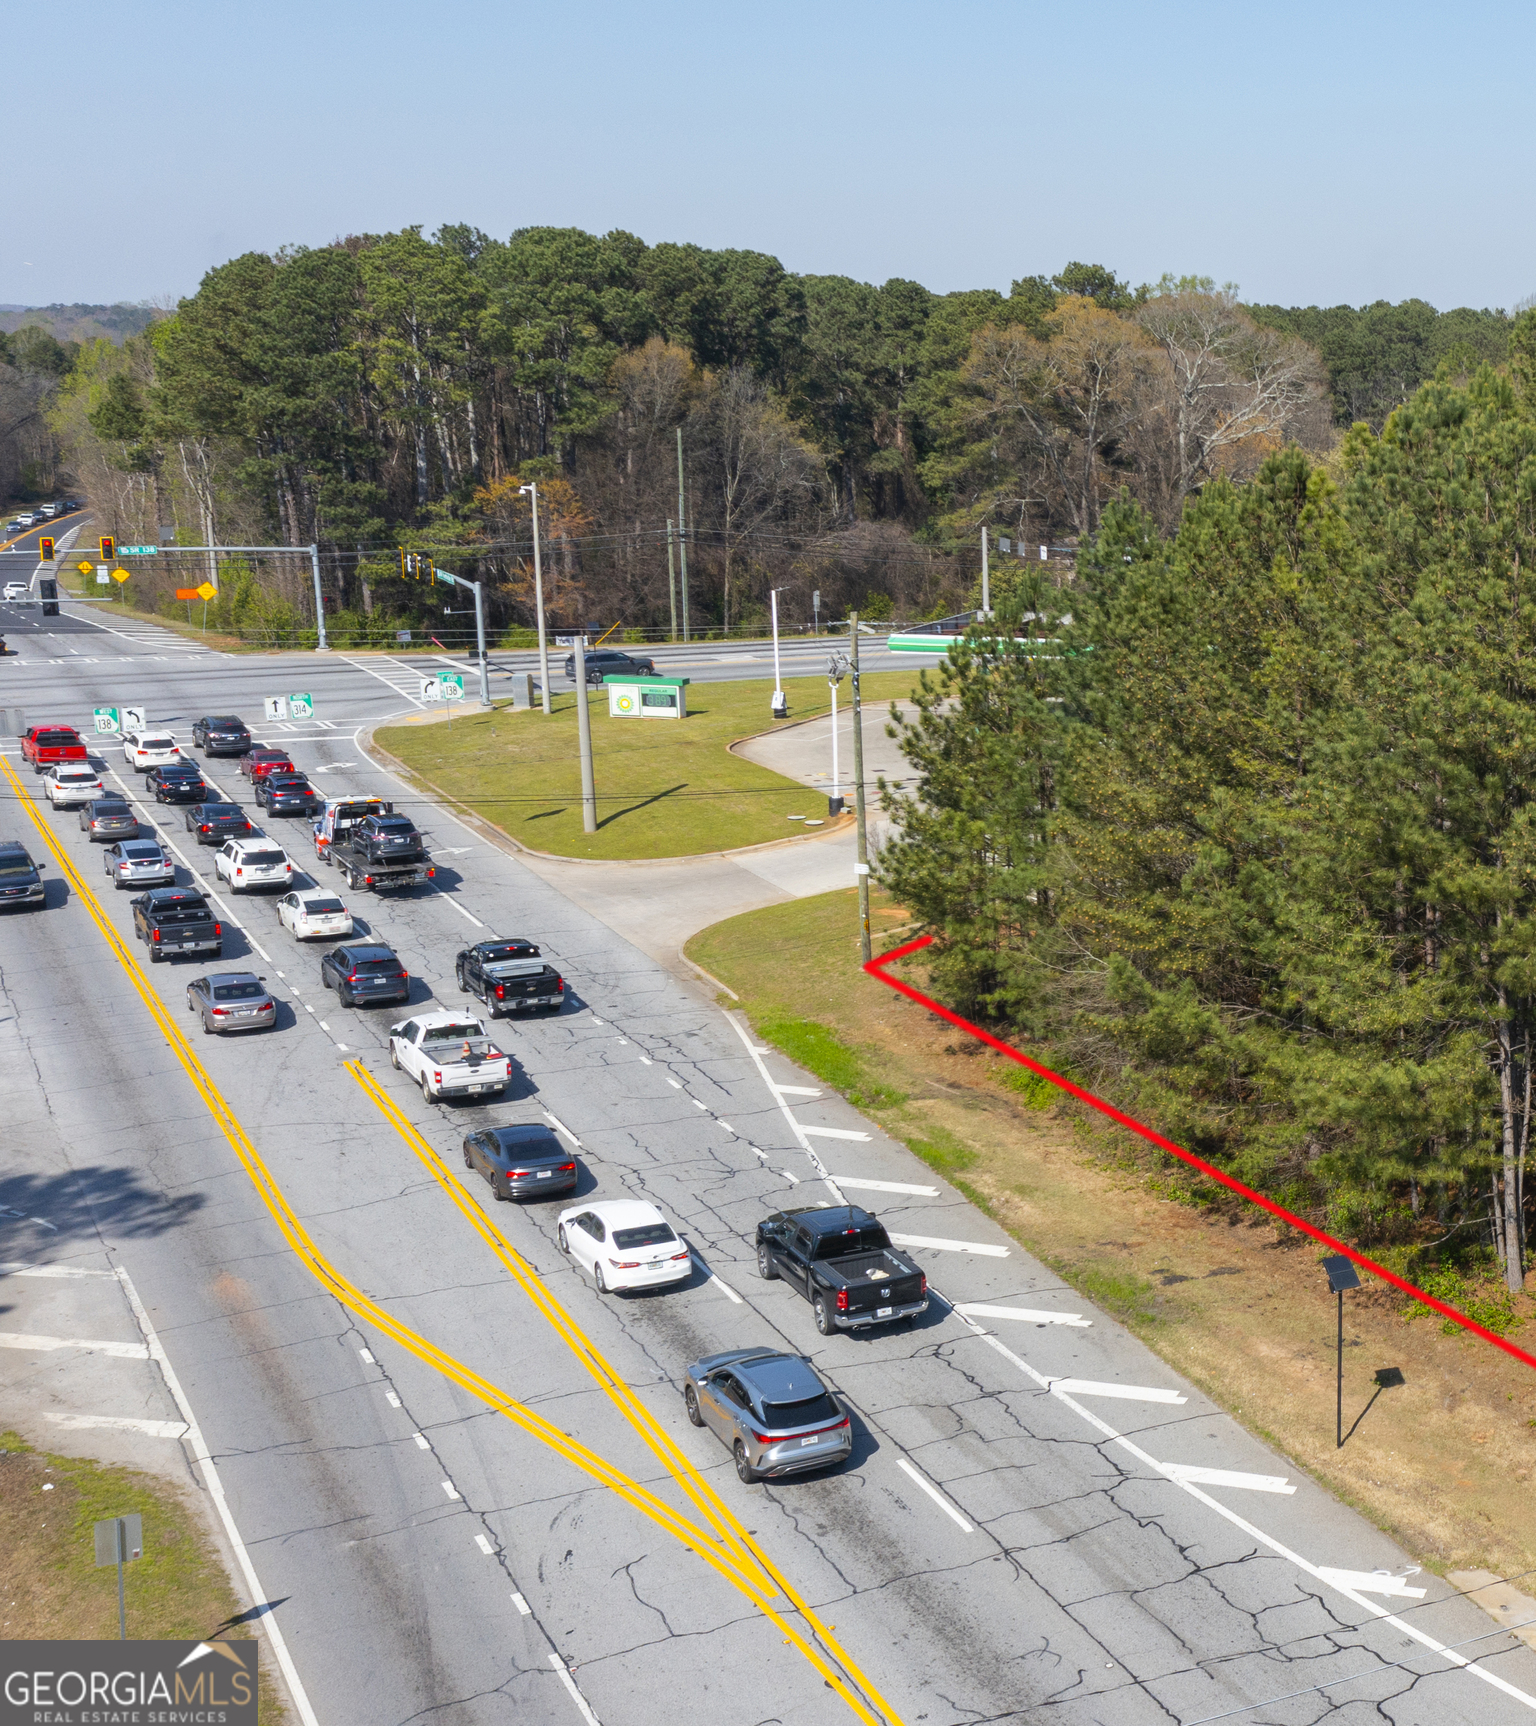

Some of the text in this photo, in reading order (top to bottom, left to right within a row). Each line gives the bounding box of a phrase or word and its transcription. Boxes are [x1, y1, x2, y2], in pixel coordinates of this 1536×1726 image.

[143, 545, 155, 553] 138
[445, 685, 458, 696] 138
[294, 704, 307, 715] 314
[98, 718, 112, 730] 138
